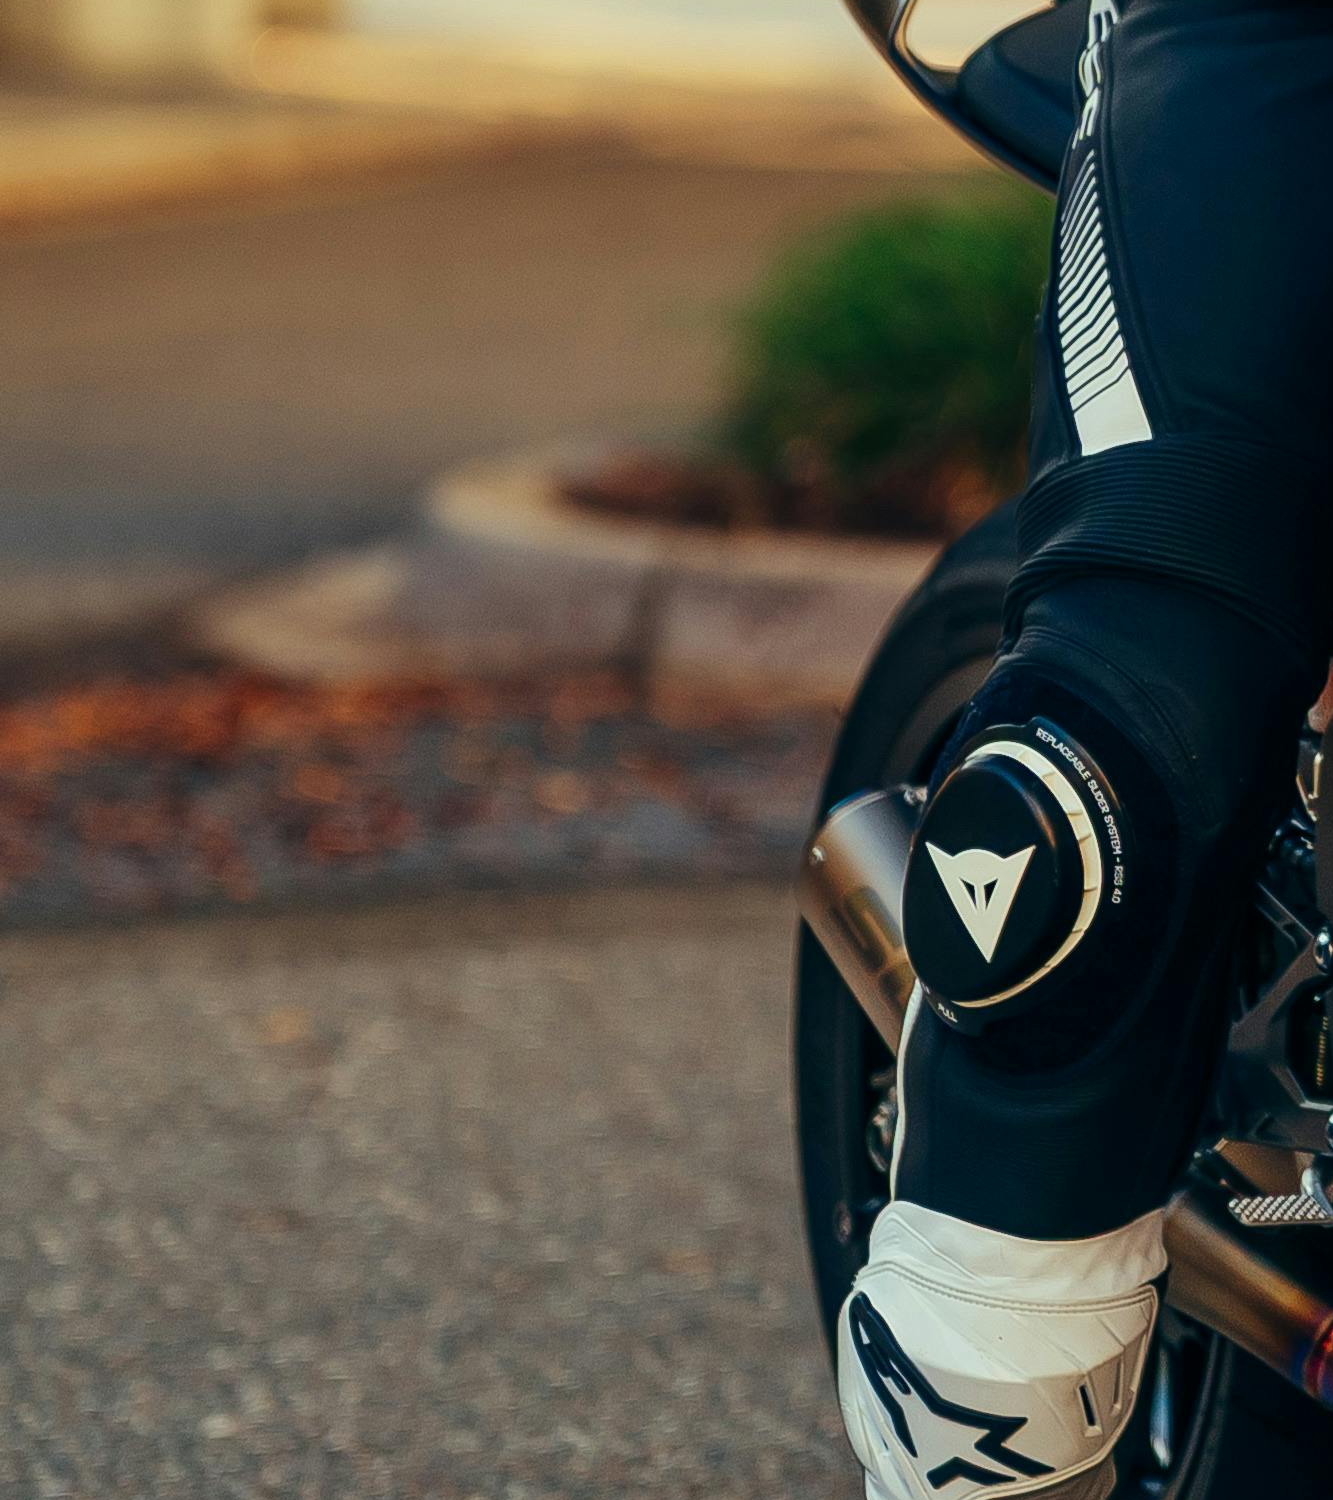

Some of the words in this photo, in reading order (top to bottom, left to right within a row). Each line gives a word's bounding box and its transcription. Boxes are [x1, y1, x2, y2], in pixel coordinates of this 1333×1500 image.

[1036, 727, 1091, 781] REPLACEABLE
[1088, 779, 1110, 814] SLIDER
[1104, 815, 1123, 855] SYSTEM
